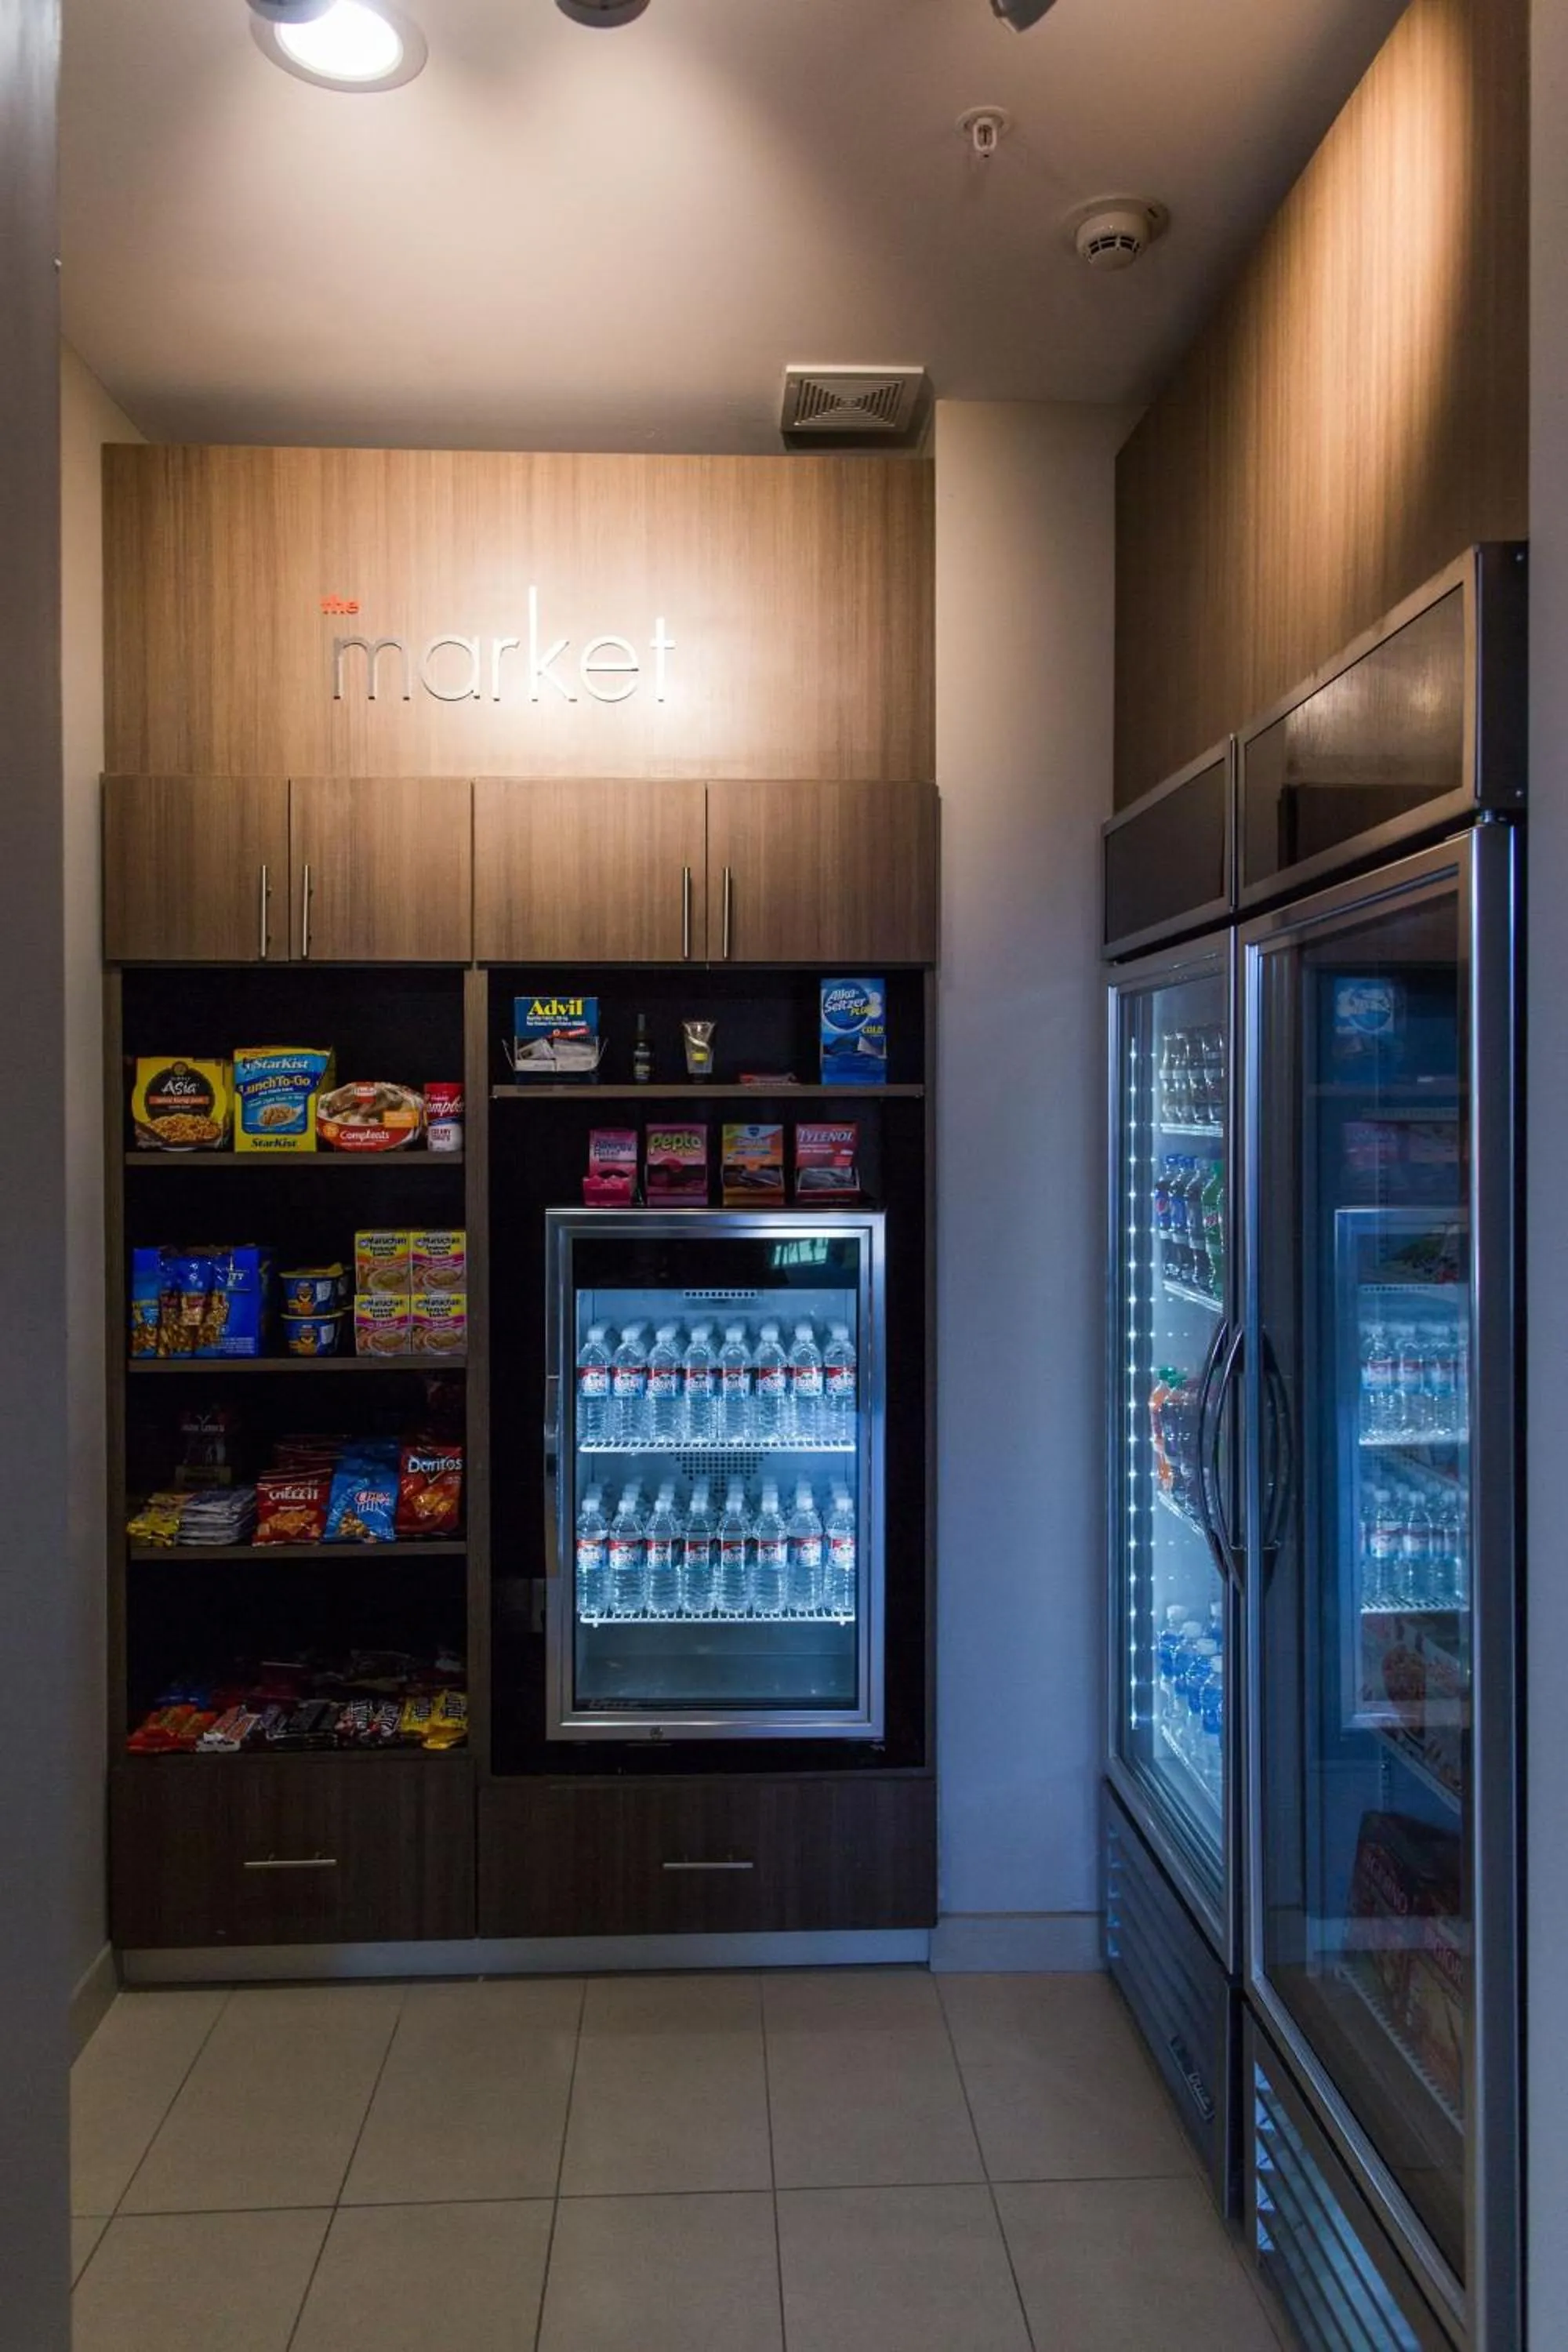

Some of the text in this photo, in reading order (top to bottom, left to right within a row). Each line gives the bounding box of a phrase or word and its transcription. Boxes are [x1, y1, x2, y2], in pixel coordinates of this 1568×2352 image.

[320, 594, 360, 615] the
[332, 585, 676, 702] market
[529, 999, 583, 1016] Advil
[825, 998, 866, 1013] Seltzer
[253, 1058, 309, 1070] StarKist
[161, 1080, 198, 1095] Asia
[339, 1129, 390, 1142] Compleats
[799, 1129, 854, 1142] TYLENOL
[250, 1138, 297, 1149] StarKist
[648, 1131, 702, 1156] pepto
[408, 1454, 463, 1474] Doritos
